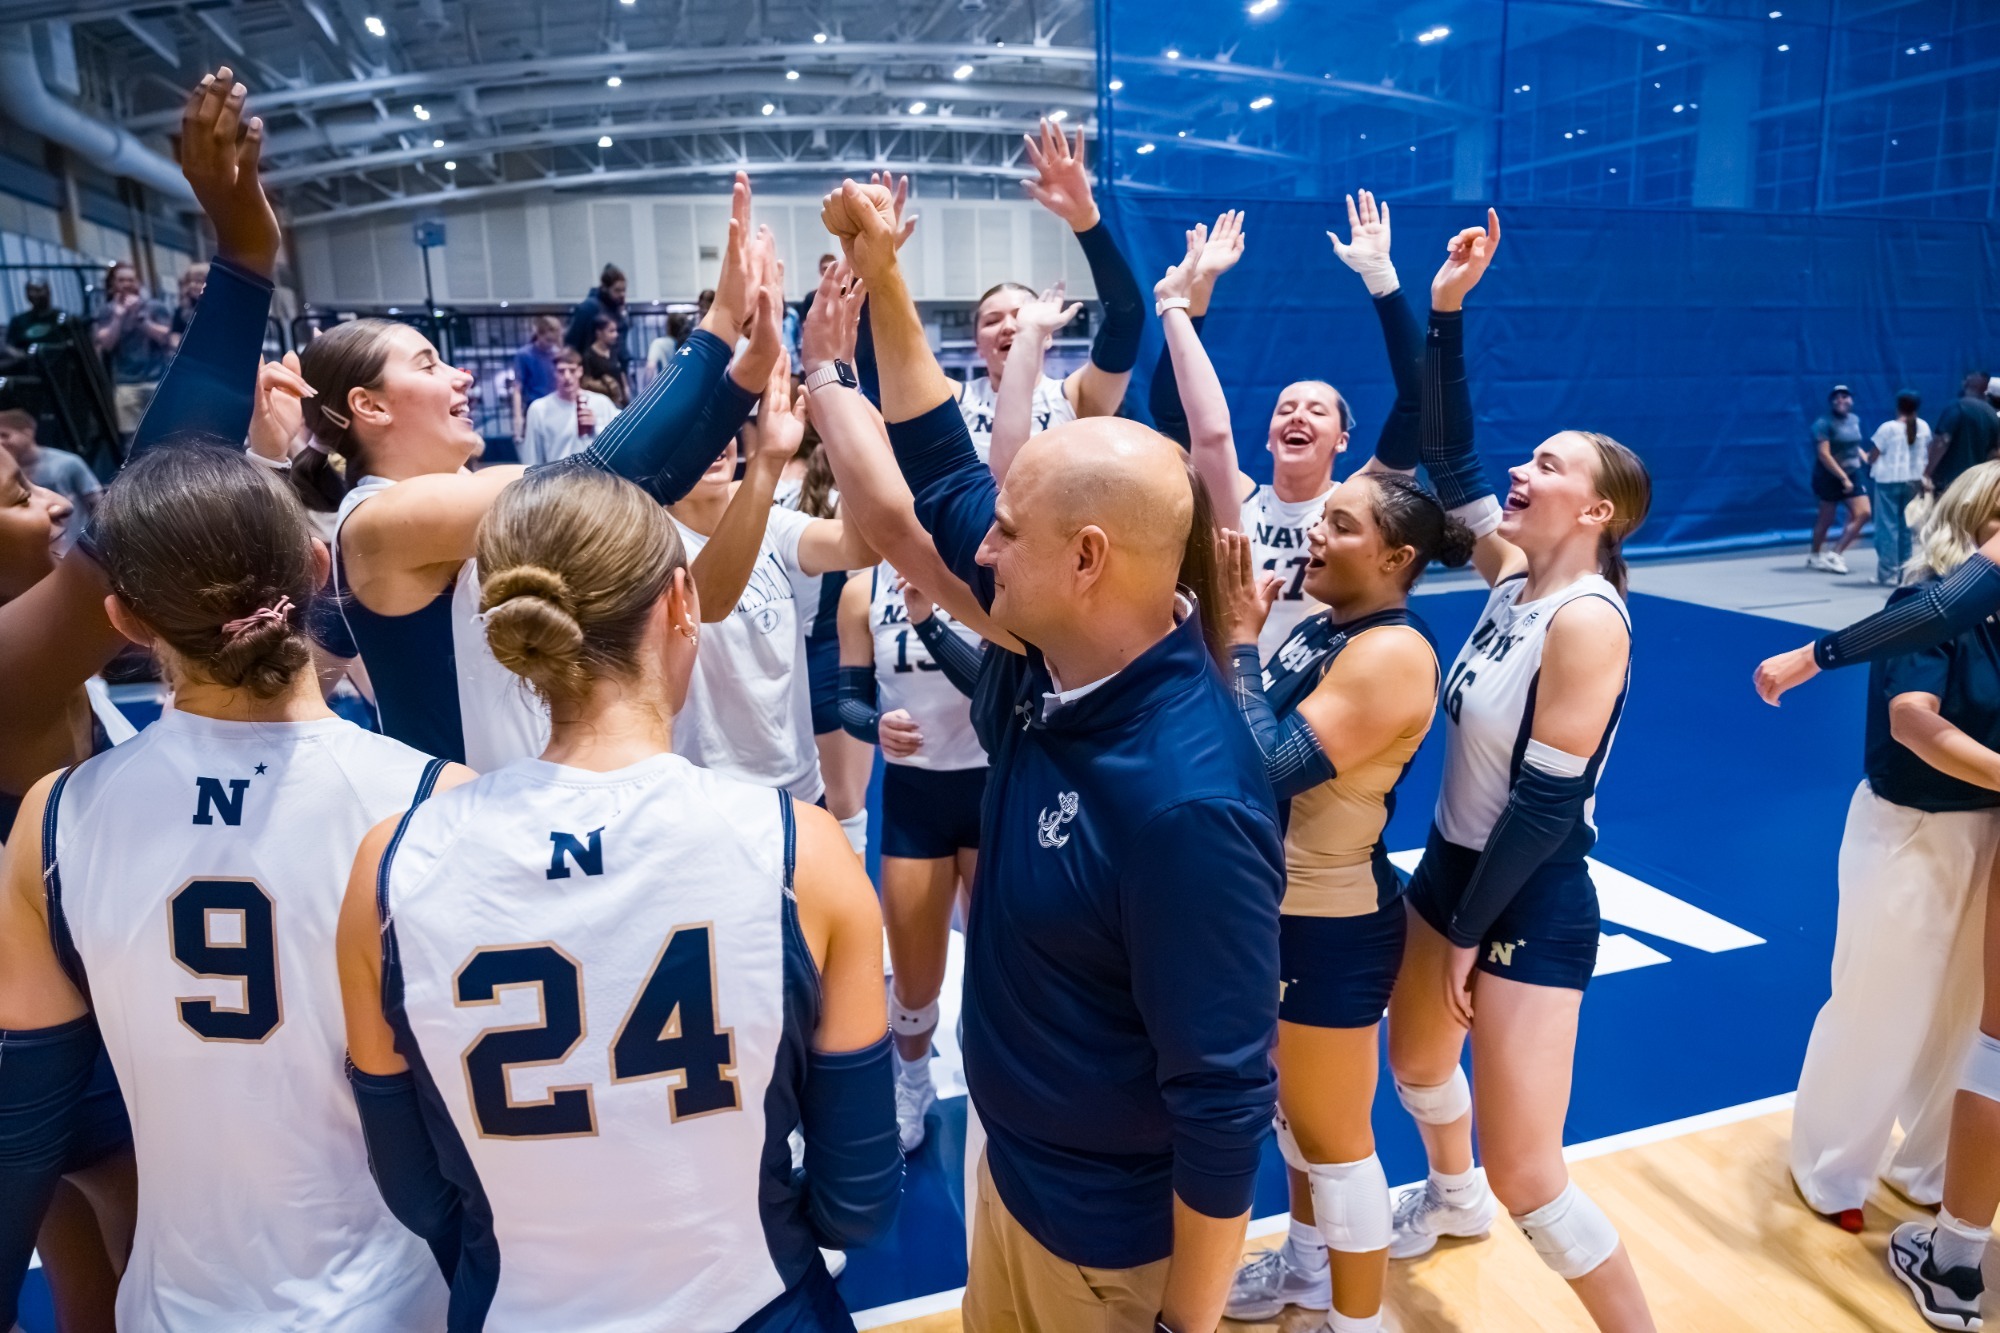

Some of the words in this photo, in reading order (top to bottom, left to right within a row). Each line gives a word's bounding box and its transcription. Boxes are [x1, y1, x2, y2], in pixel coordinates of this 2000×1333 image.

[1279, 631, 1327, 673] NAVY
[1471, 618, 1525, 662] NAVY
[1443, 662, 1477, 727] 16
[192, 777, 250, 825] N
[546, 826, 605, 880] N
[166, 876, 285, 1044] 9
[1488, 941, 1515, 966] N
[452, 920, 743, 1141] 24
